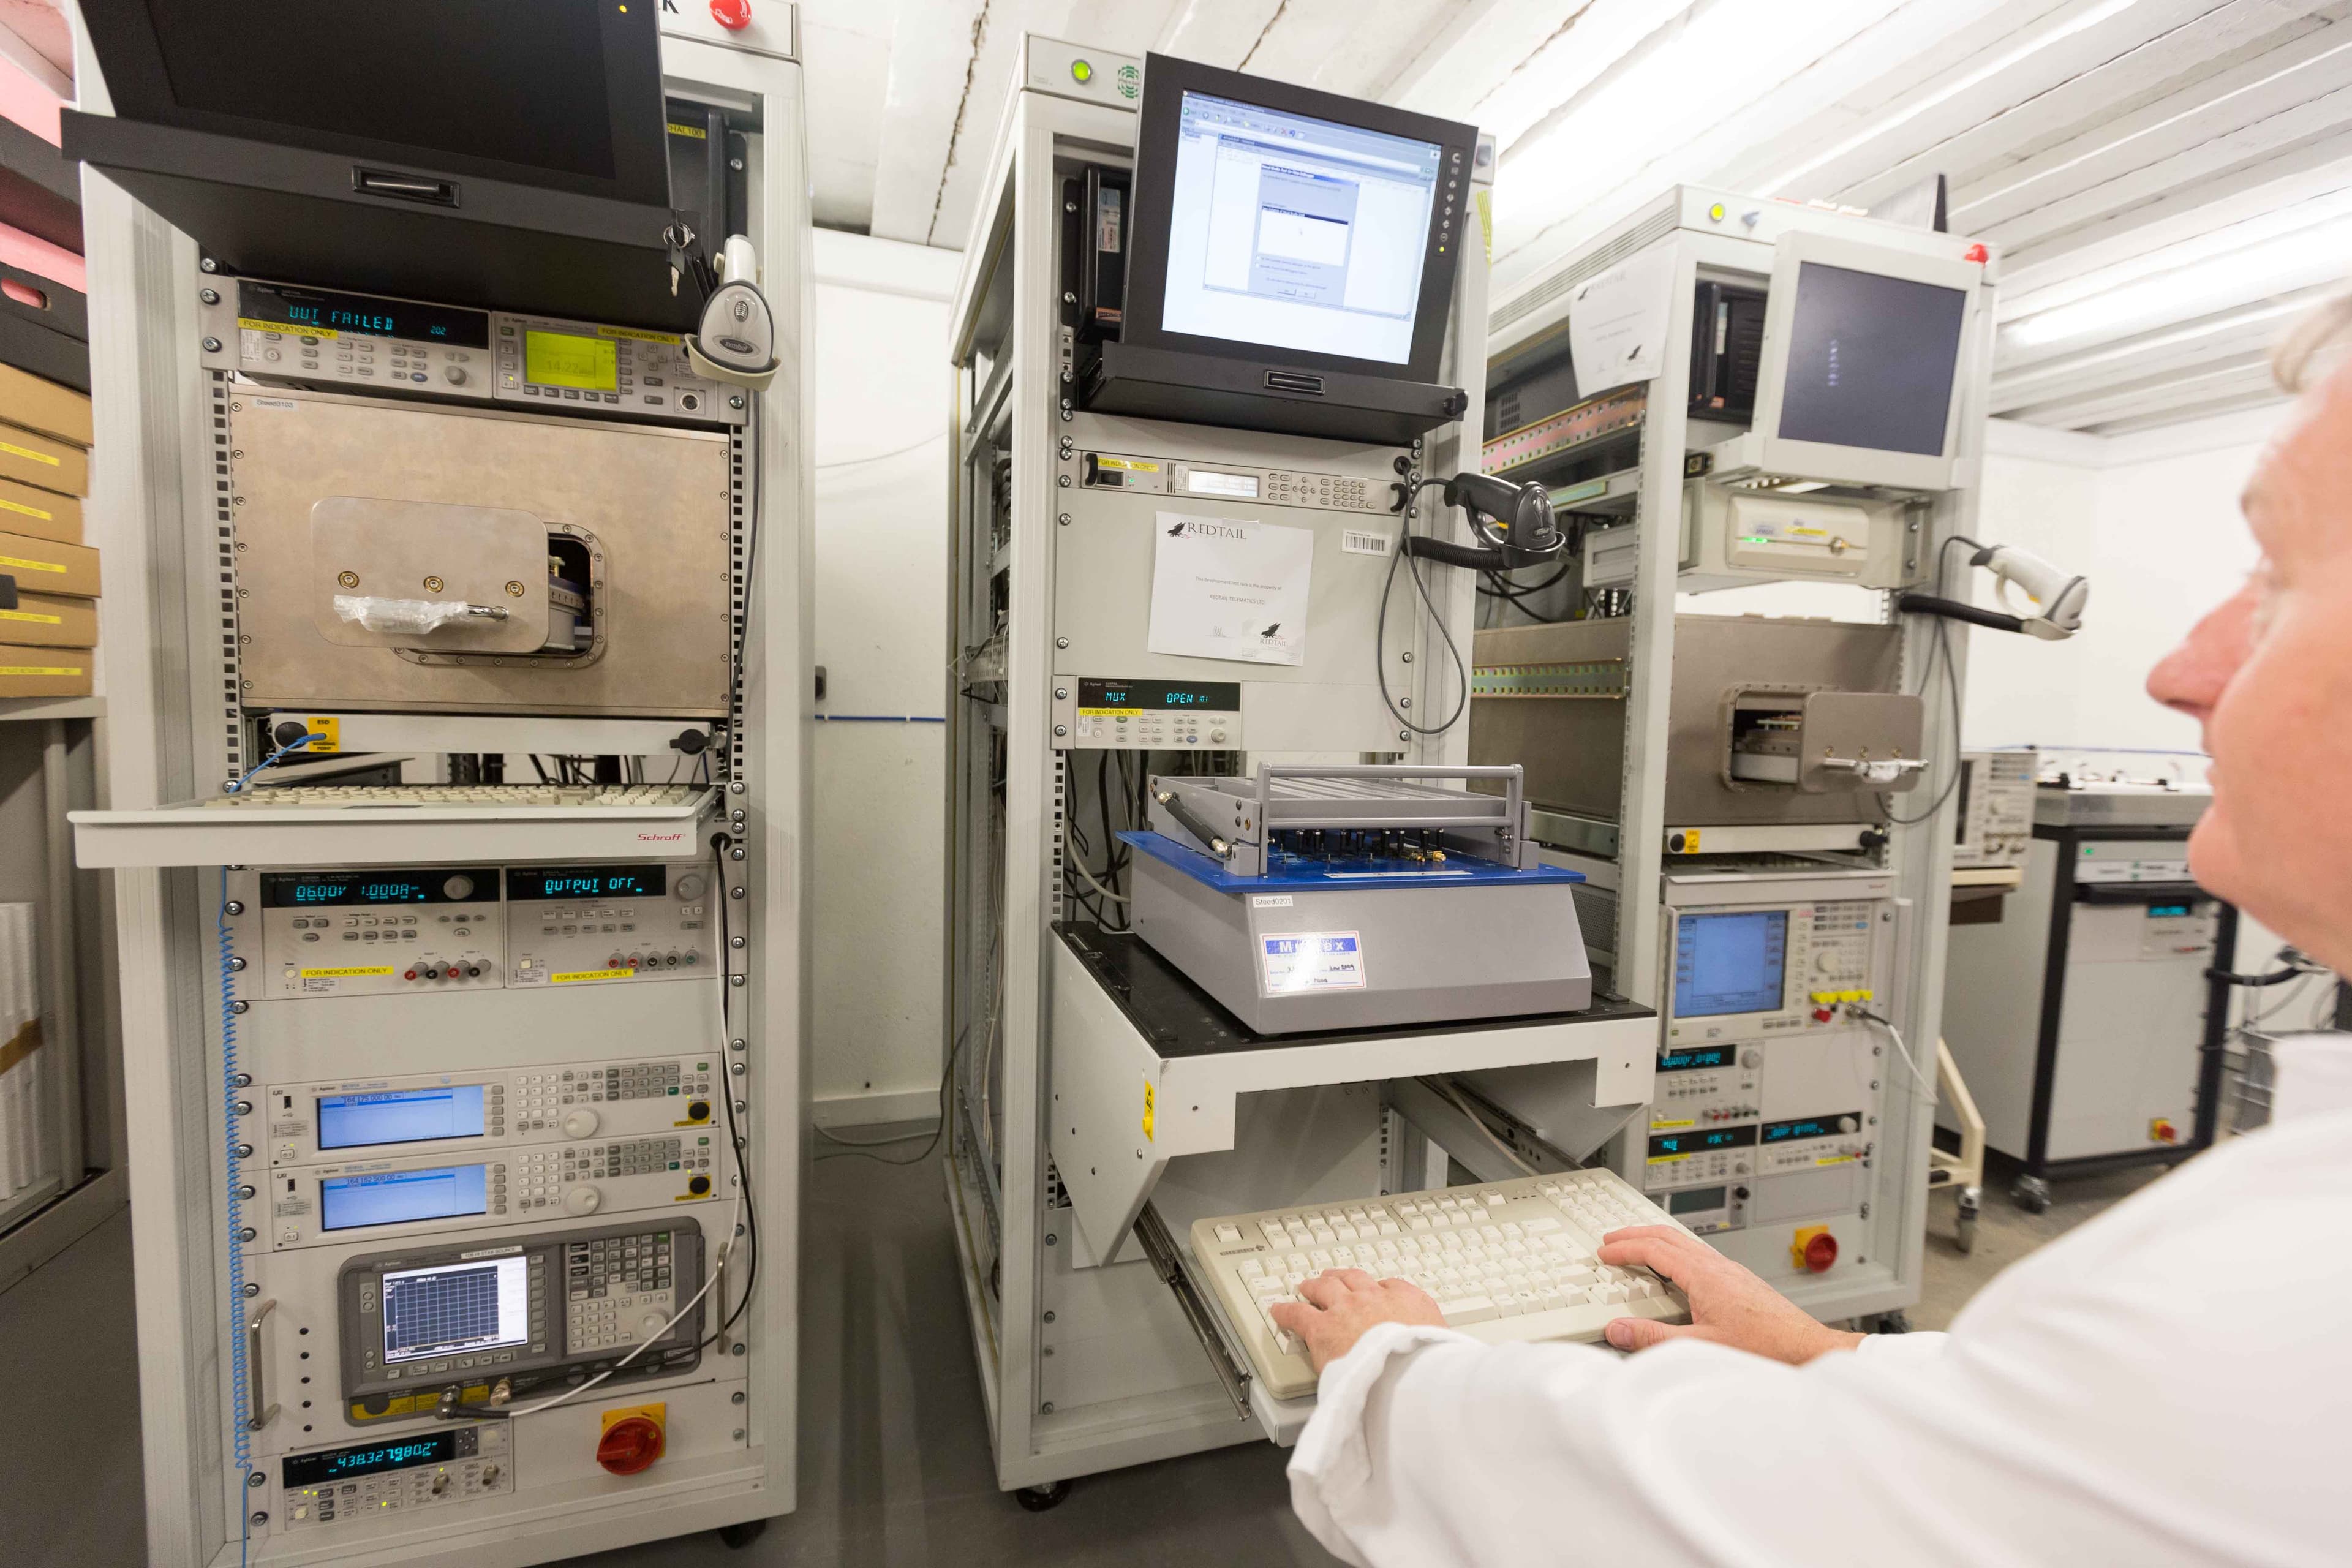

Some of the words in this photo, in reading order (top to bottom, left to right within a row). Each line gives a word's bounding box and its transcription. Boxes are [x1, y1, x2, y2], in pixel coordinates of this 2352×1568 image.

[331, 311, 393, 331] FAILED
[244, 320, 262, 330] FOR
[263, 323, 311, 336] INDICATION
[311, 329, 332, 337] ONLY
[619, 330, 655, 340] INDICATION
[257, 399, 293, 408] Steed0103
[1188, 522, 1247, 539] REDTAIL
[1106, 692, 1126, 701] MUX
[1167, 693, 1193, 703] OPEN
[545, 878, 599, 892] OUTPUT
[609, 877, 635, 889] OFF
[572, 971, 609, 979] INDICATION
